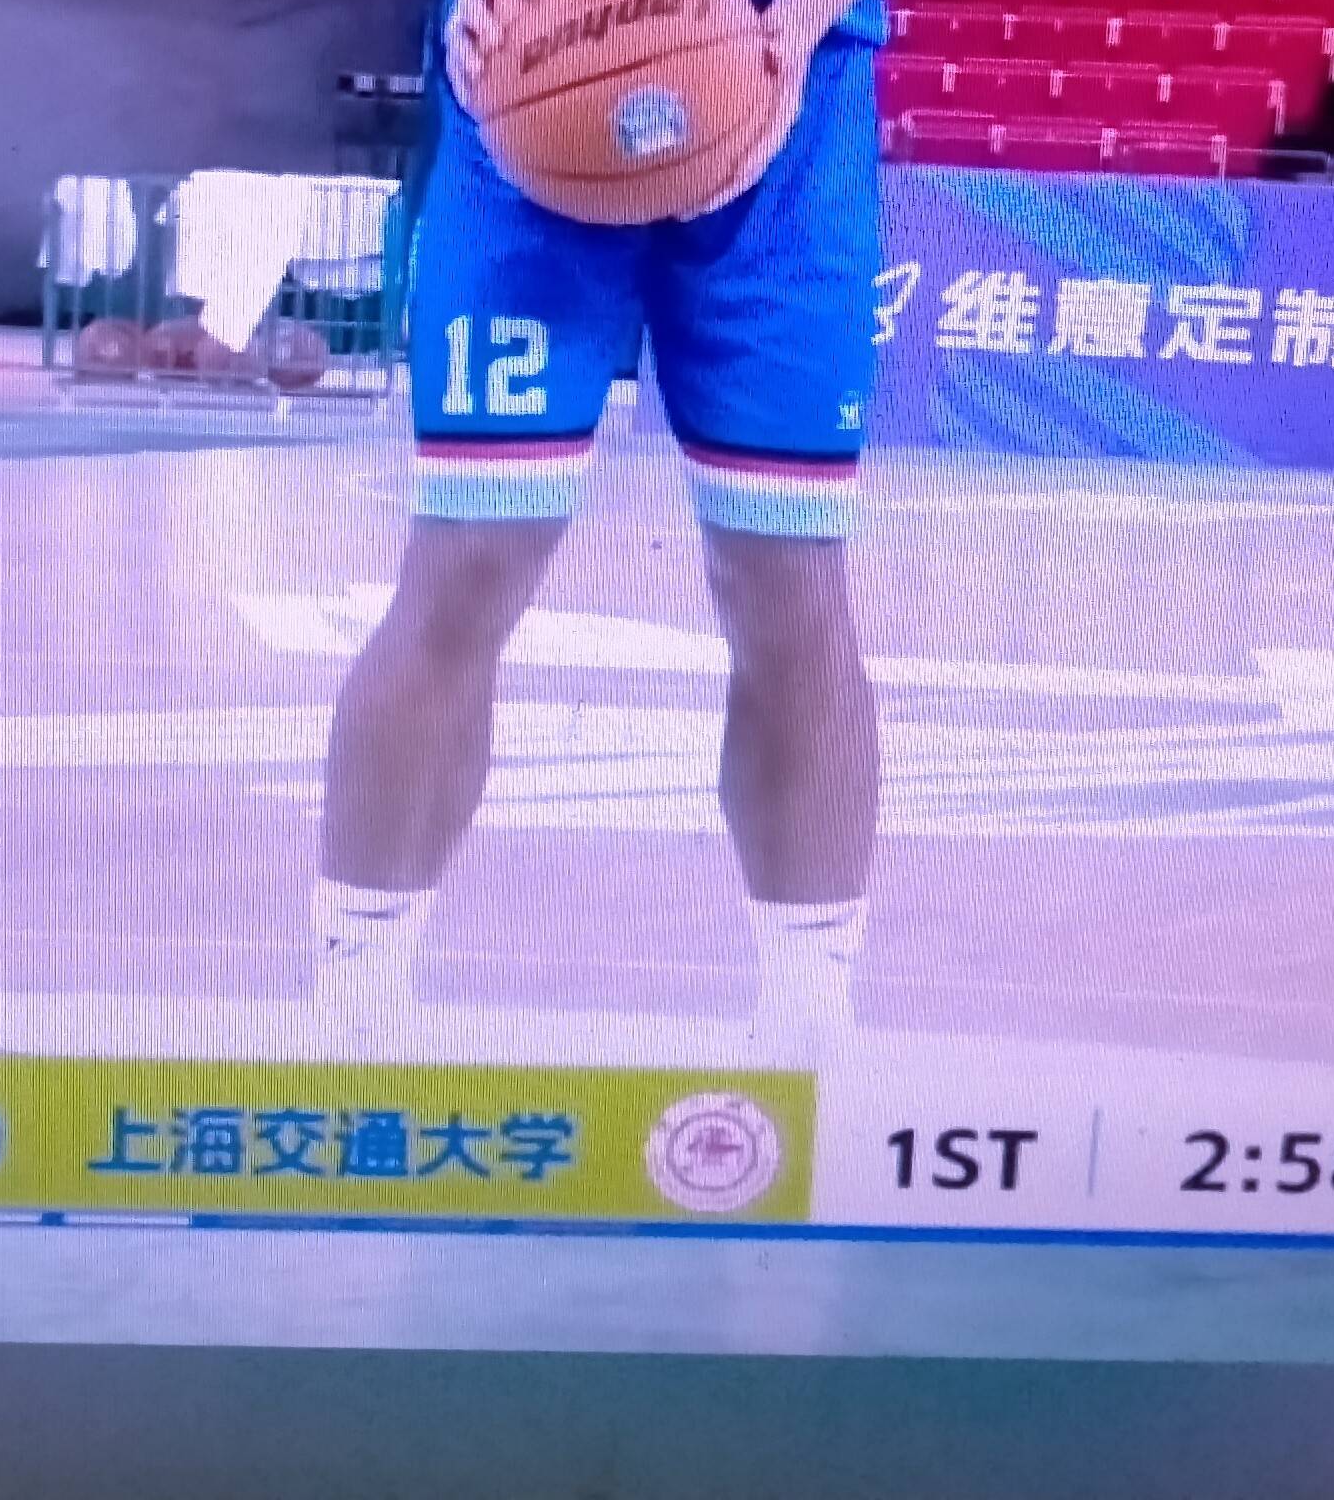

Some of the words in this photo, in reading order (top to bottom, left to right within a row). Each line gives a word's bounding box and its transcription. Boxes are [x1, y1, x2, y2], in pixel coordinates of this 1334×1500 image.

[441, 315, 549, 417] 12
[87, 1103, 576, 1182] 上海交通大学
[886, 1127, 1040, 1193] 1ST
